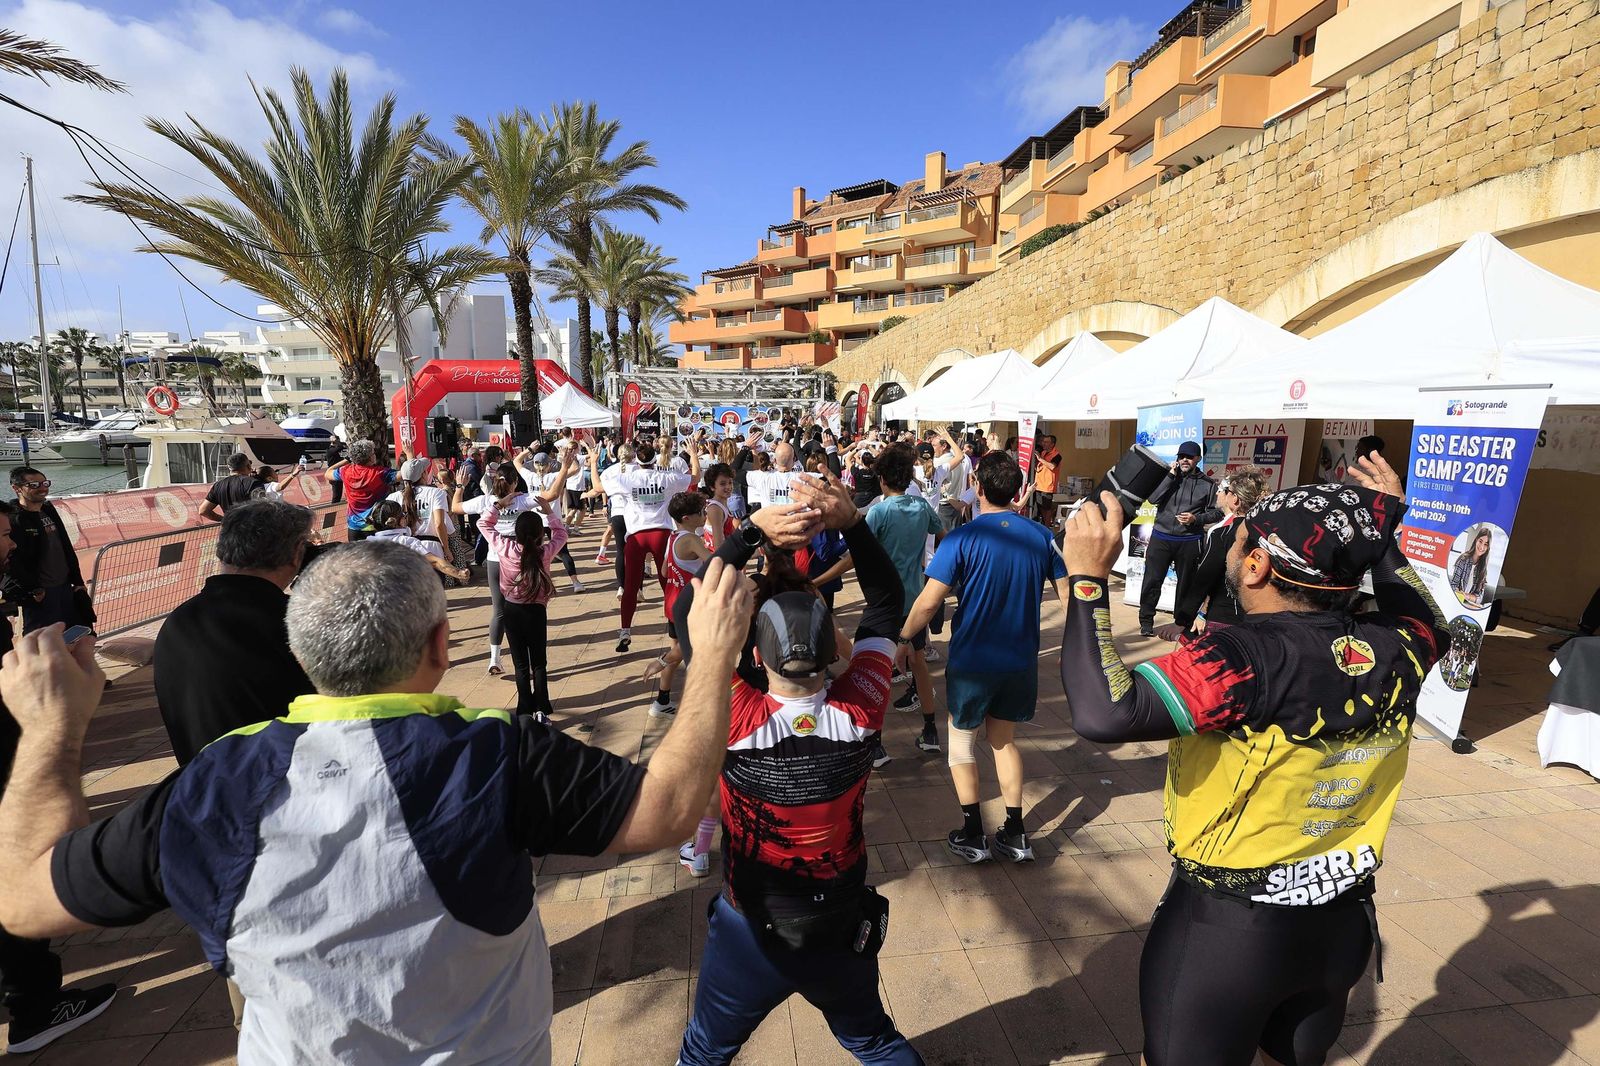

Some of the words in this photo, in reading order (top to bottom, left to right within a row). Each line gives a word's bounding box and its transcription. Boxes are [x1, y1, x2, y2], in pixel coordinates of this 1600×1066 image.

[1465, 400, 1508, 411] Sotogrande
[1158, 428, 1181, 439] JOIN
[1184, 426, 1197, 438] US
[1206, 423, 1286, 436] BETANIA
[1325, 421, 1368, 436] BETANIA
[1417, 433, 1446, 455] SIS
[1448, 435, 1516, 460] EASTER
[1415, 457, 1462, 481] CAMP
[1462, 462, 1508, 487] 2026
[639, 484, 665, 495] mile
[1413, 480, 1430, 489] FIRST
[1431, 482, 1453, 492] EDITION
[1411, 497, 1431, 508] From
[1431, 500, 1446, 510] 6th
[1446, 503, 1453, 511] to
[1453, 504, 1471, 515] 10th
[1410, 508, 1428, 519] April
[1428, 512, 1446, 522] 2026
[1407, 530, 1419, 539] One
[317, 768, 348, 779] CRIVIT
[1266, 845, 1377, 893] SIERRA
